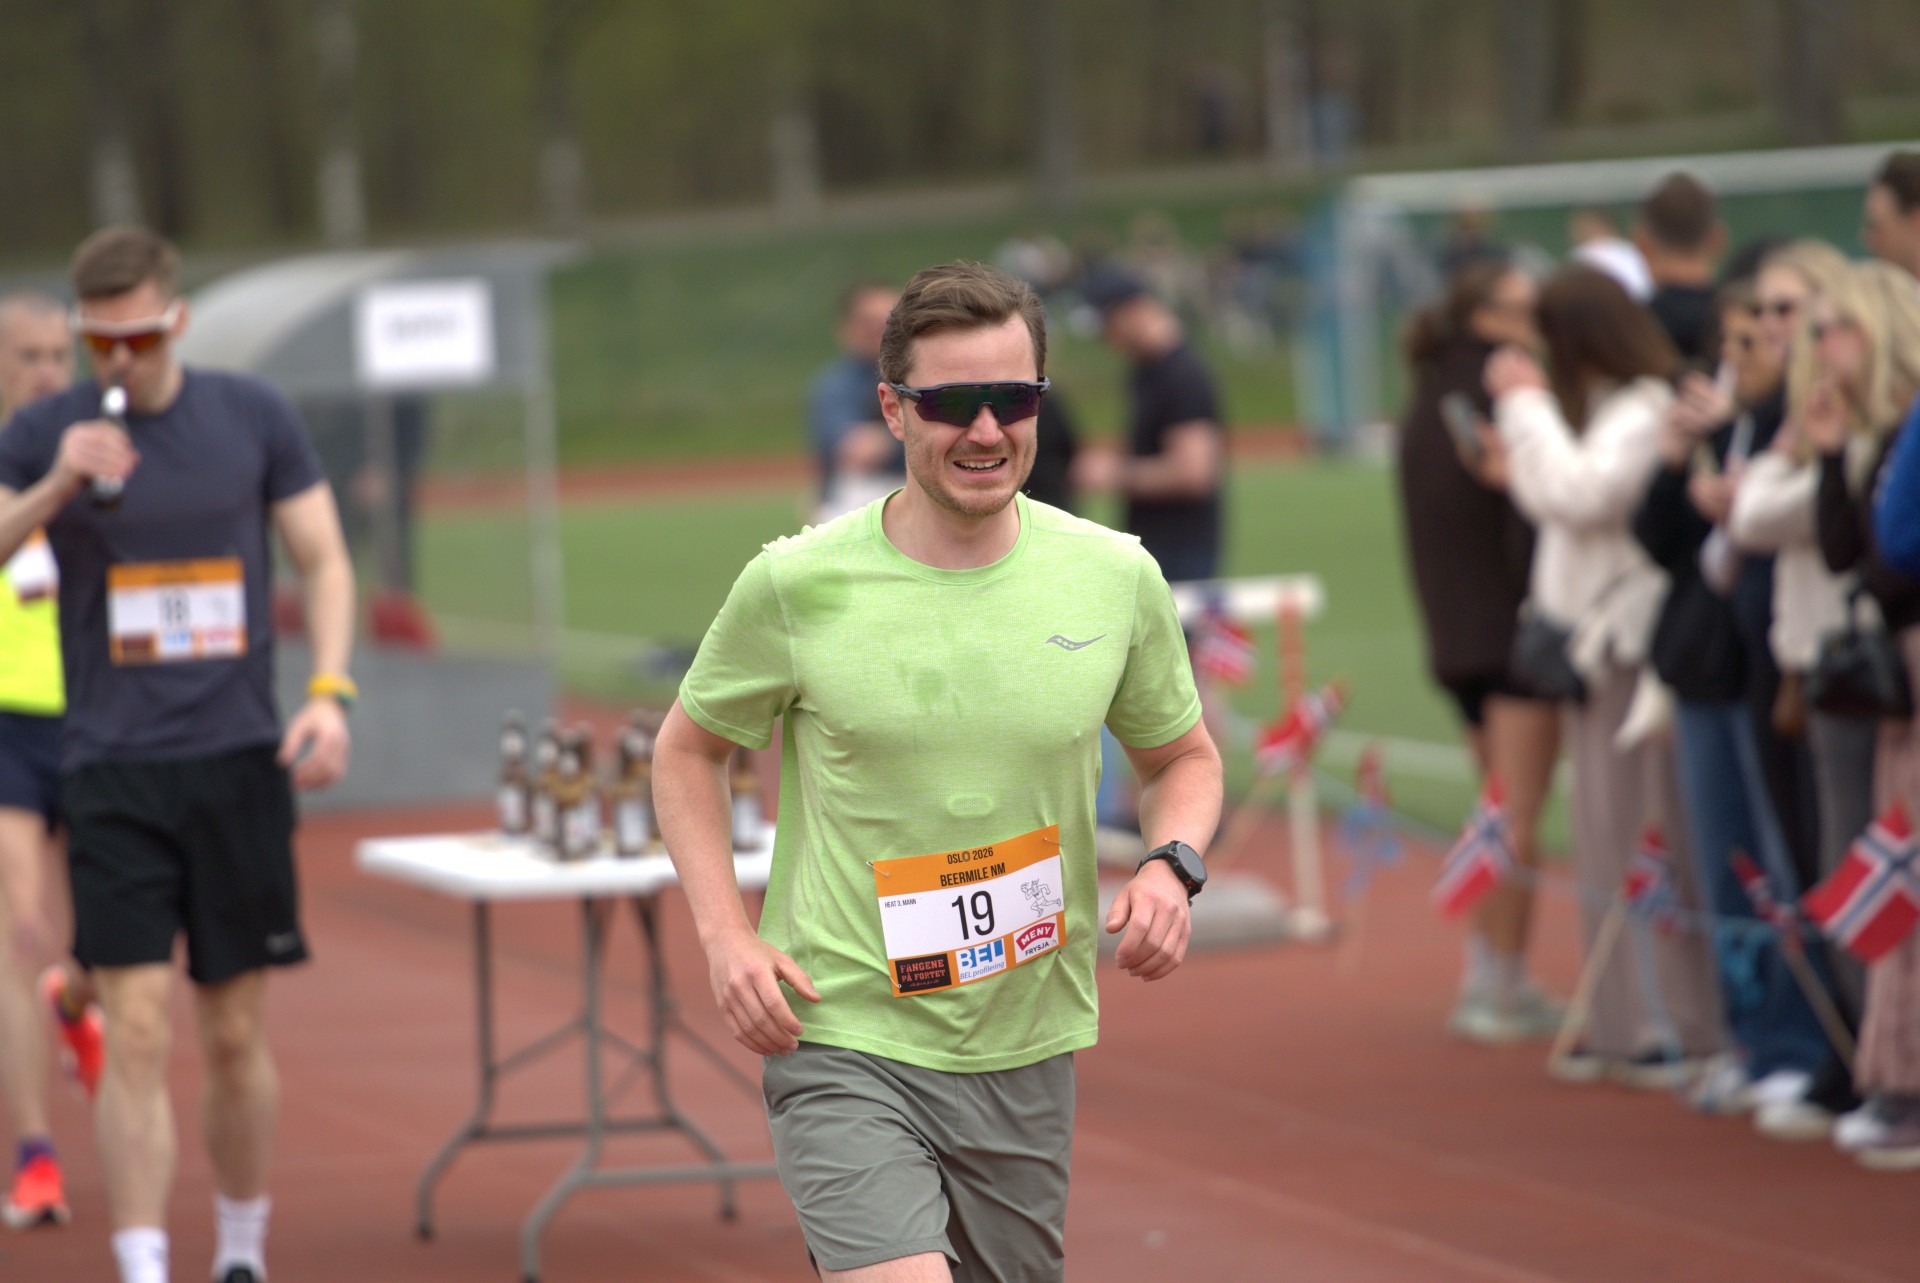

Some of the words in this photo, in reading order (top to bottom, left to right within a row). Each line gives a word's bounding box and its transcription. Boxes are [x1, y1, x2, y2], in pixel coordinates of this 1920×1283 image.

[947, 851, 971, 864] OSLO
[972, 847, 993, 860] 2026
[940, 867, 989, 886] BEERMILE
[991, 862, 1006, 877] NM
[952, 890, 995, 940] 19
[1020, 926, 1051, 946] MENY
[1025, 941, 1050, 956] FRYSJA
[900, 959, 944, 973] FANGENE
[972, 962, 1004, 978] profilering
[901, 973, 912, 982] PÅ
[914, 969, 946, 980] FORTET
